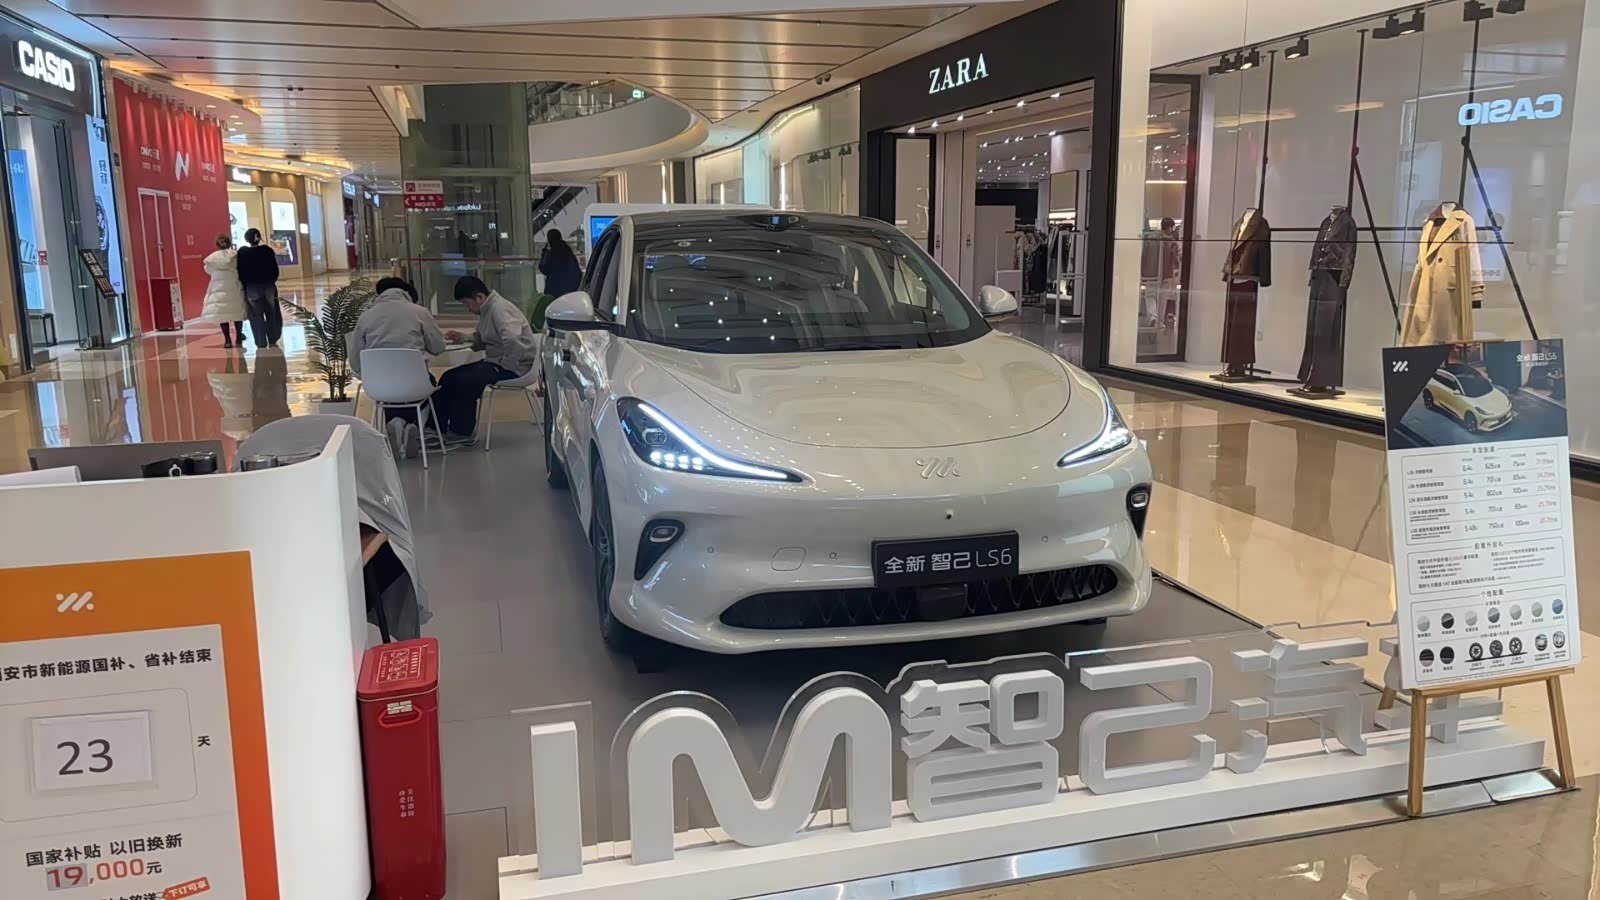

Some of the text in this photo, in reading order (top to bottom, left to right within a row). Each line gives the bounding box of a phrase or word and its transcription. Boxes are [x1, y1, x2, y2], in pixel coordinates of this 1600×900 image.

[18, 40, 75, 92] CASIO
[928, 52, 989, 95] ZARA
[884, 548, 1012, 574] 全新 智己LS6
[0, 648, 212, 682] 安市新能源国补、省补结束
[57, 739, 113, 775] 23
[197, 735, 211, 747] 天
[26, 833, 183, 867] 国家补贴 以旧换新
[47, 858, 162, 888] 19,000元
[168, 880, 207, 898] 下订可享
